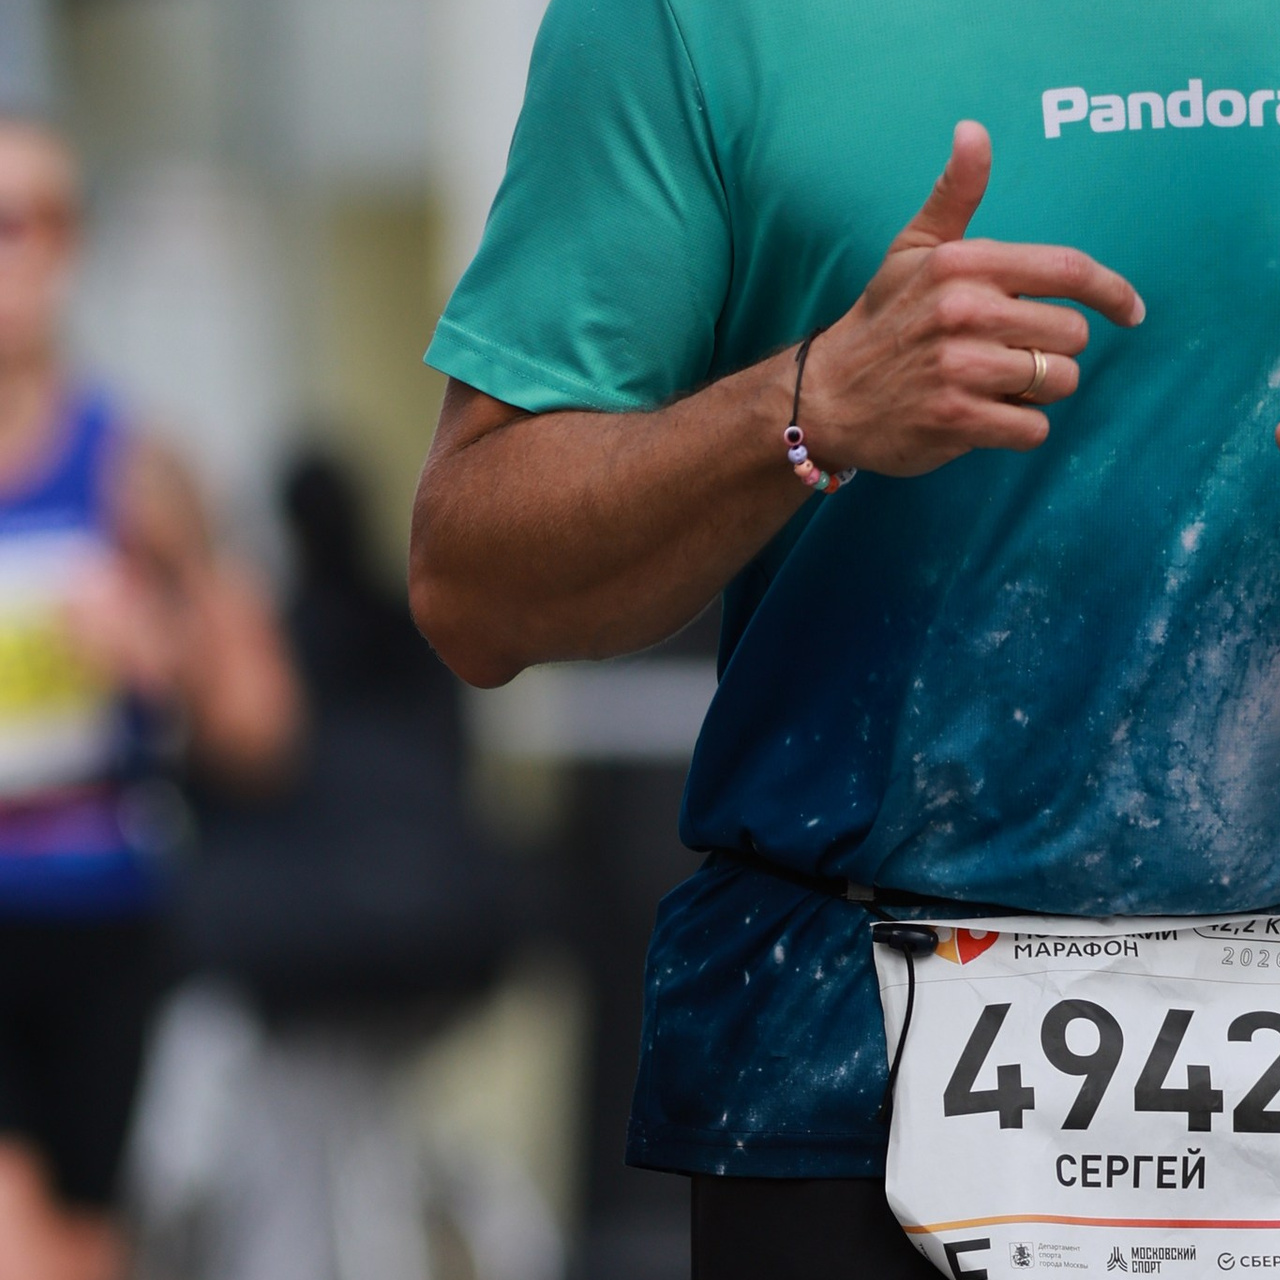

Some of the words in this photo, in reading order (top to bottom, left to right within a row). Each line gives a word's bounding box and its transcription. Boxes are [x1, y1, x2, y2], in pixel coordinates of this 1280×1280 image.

[1014, 939, 1139, 959] МАРАФОН
[1055, 1148, 1206, 1190] СЕРГЕЙ
[1038, 1242, 1081, 1252] Департамент
[1131, 1244, 1196, 1261] МОСКОВСКИЙ
[1038, 1252, 1061, 1260] спорта
[1039, 1261, 1062, 1269] города
[1063, 1261, 1088, 1269] Москвы
[1131, 1260, 1162, 1274] СПОРТ
